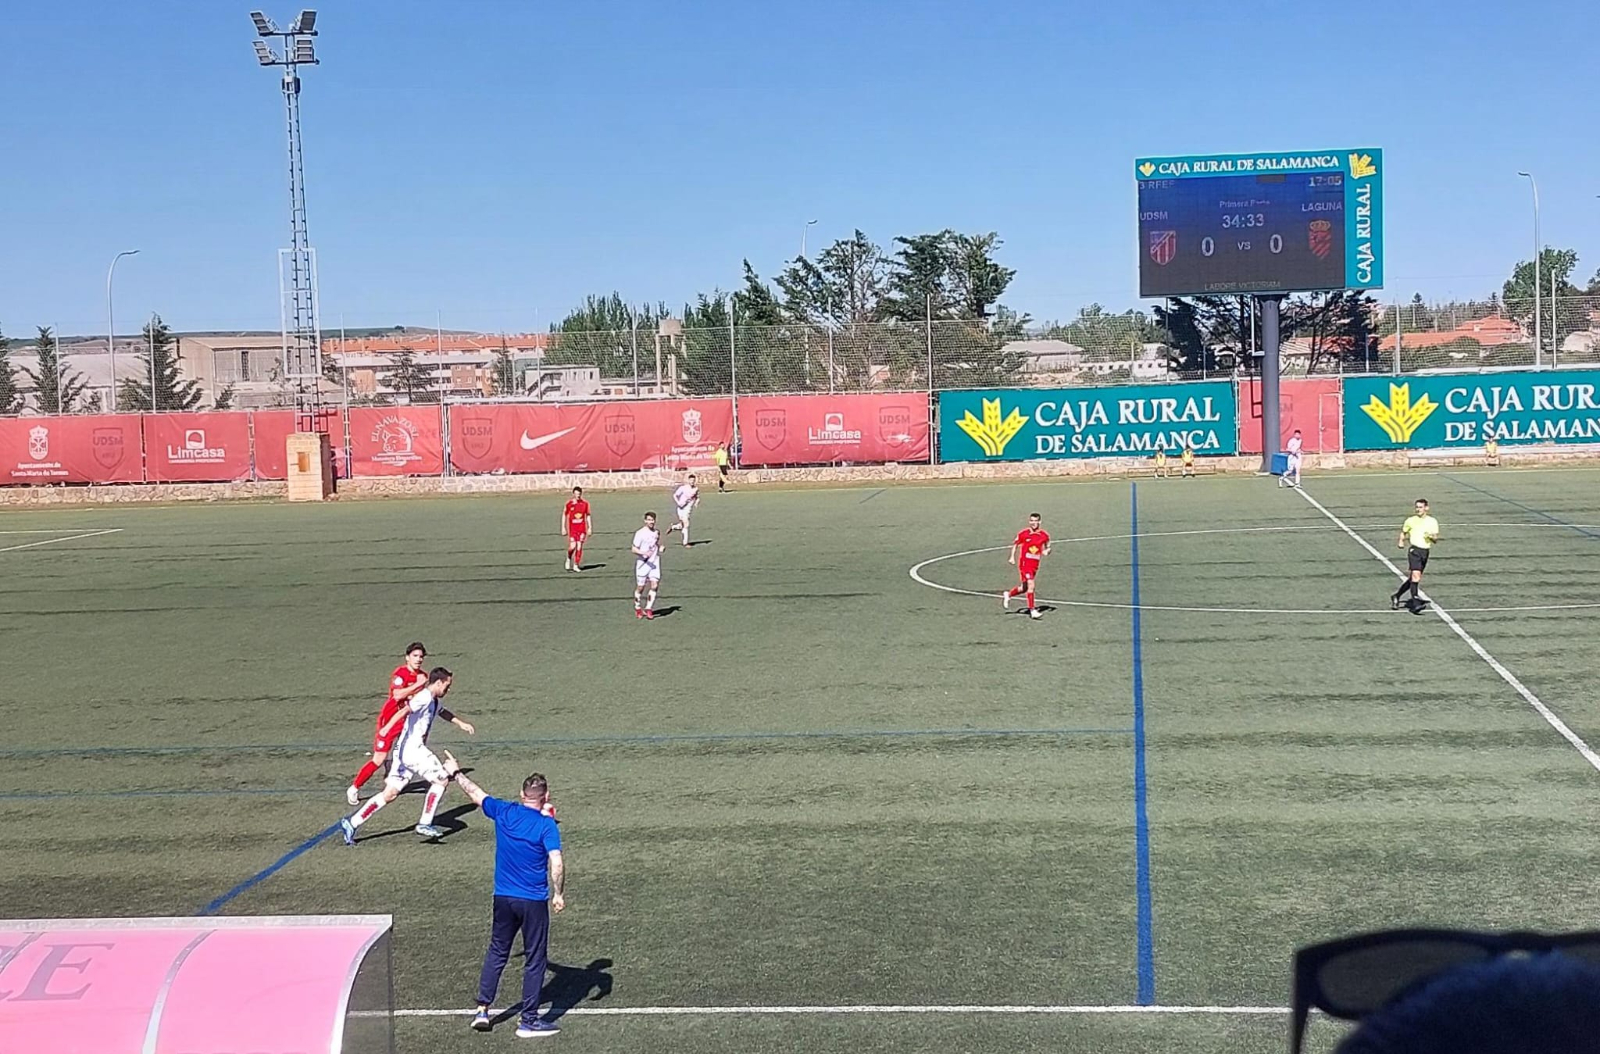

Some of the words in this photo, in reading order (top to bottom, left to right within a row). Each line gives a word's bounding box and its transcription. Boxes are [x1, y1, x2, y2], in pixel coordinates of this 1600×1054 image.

[1159, 162, 1190, 176] CAJA
[1193, 160, 1235, 173] RURAL
[1236, 159, 1254, 171] DE
[1256, 156, 1339, 170] SALAMANCA
[1139, 211, 1168, 221] UDSM
[1301, 202, 1343, 212] LAGUNA
[1356, 183, 1371, 239] RURAL
[1222, 213, 1265, 229] 34:33
[1201, 236, 1215, 257] 0
[1269, 233, 1283, 254] 0
[1356, 242, 1375, 283] CAJA
[1445, 386, 1524, 419] CAJA
[1532, 384, 1600, 411] RUR
[756, 417, 787, 427] UDSM
[879, 414, 910, 424] UDSM
[1035, 399, 1109, 432] CAJA
[1118, 396, 1220, 423] RURAL
[462, 425, 493, 436] UDSM
[604, 423, 636, 434] UDSM
[808, 426, 862, 440] Limcasa
[1445, 421, 1477, 441] DE
[1482, 418, 1600, 440] SALAMAN
[1035, 435, 1066, 454] DE
[1071, 429, 1220, 453] SALAMANCA
[167, 444, 226, 459] Limcasa
